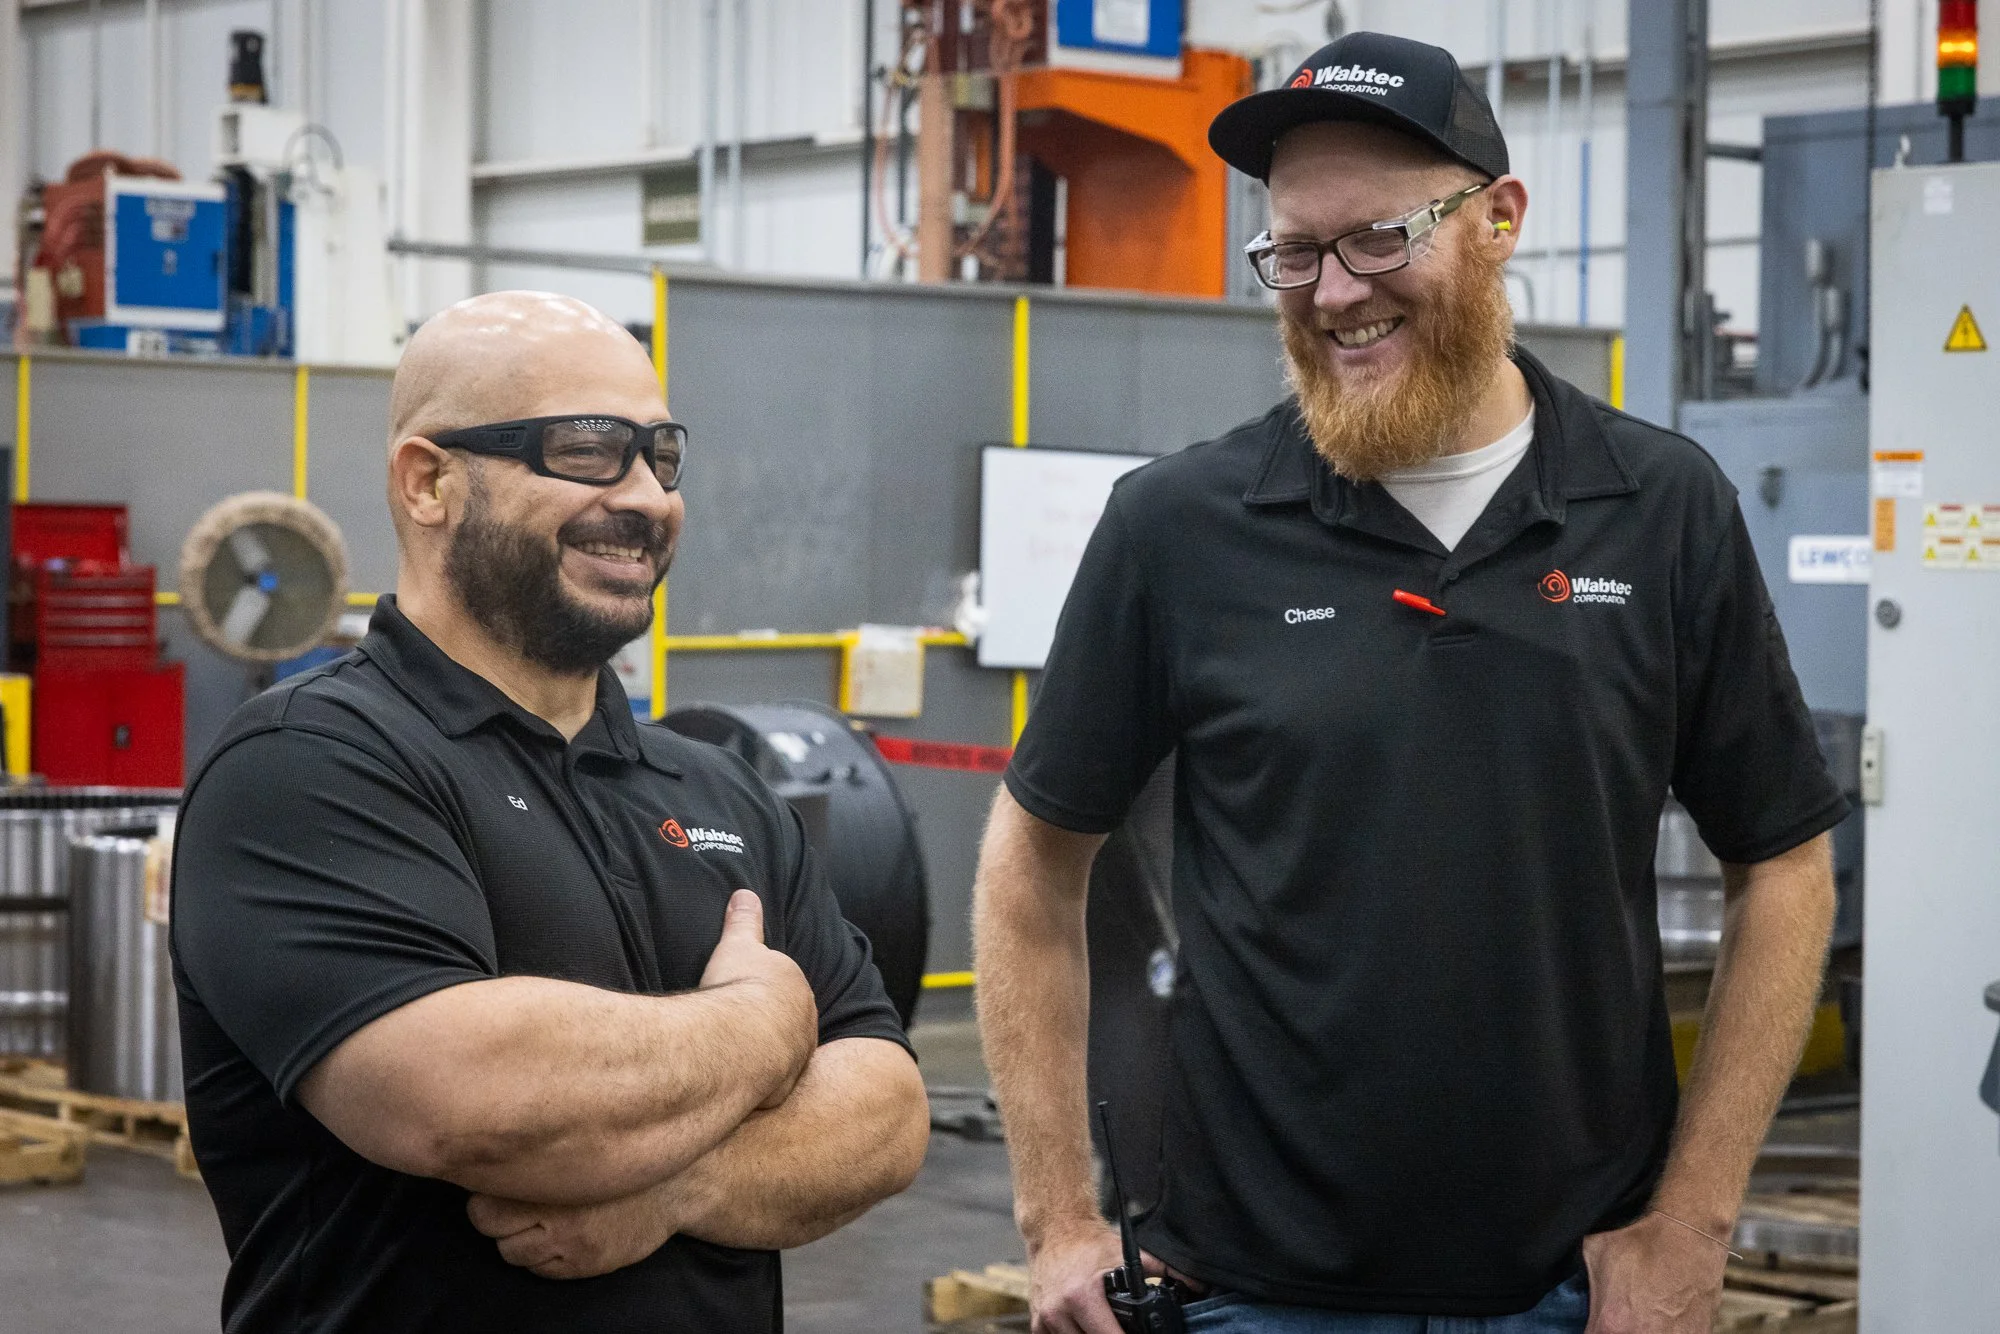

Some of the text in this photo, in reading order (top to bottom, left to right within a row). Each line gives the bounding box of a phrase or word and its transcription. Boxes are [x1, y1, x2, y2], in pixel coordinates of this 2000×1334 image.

[1314, 64, 1405, 88] Wabtec
[1571, 577, 1632, 596] Wabtec
[1572, 593, 1626, 605] CORPORATION
[1284, 607, 1336, 625] Chase
[507, 795, 529, 811] Ed
[685, 827, 745, 848] Wabtec
